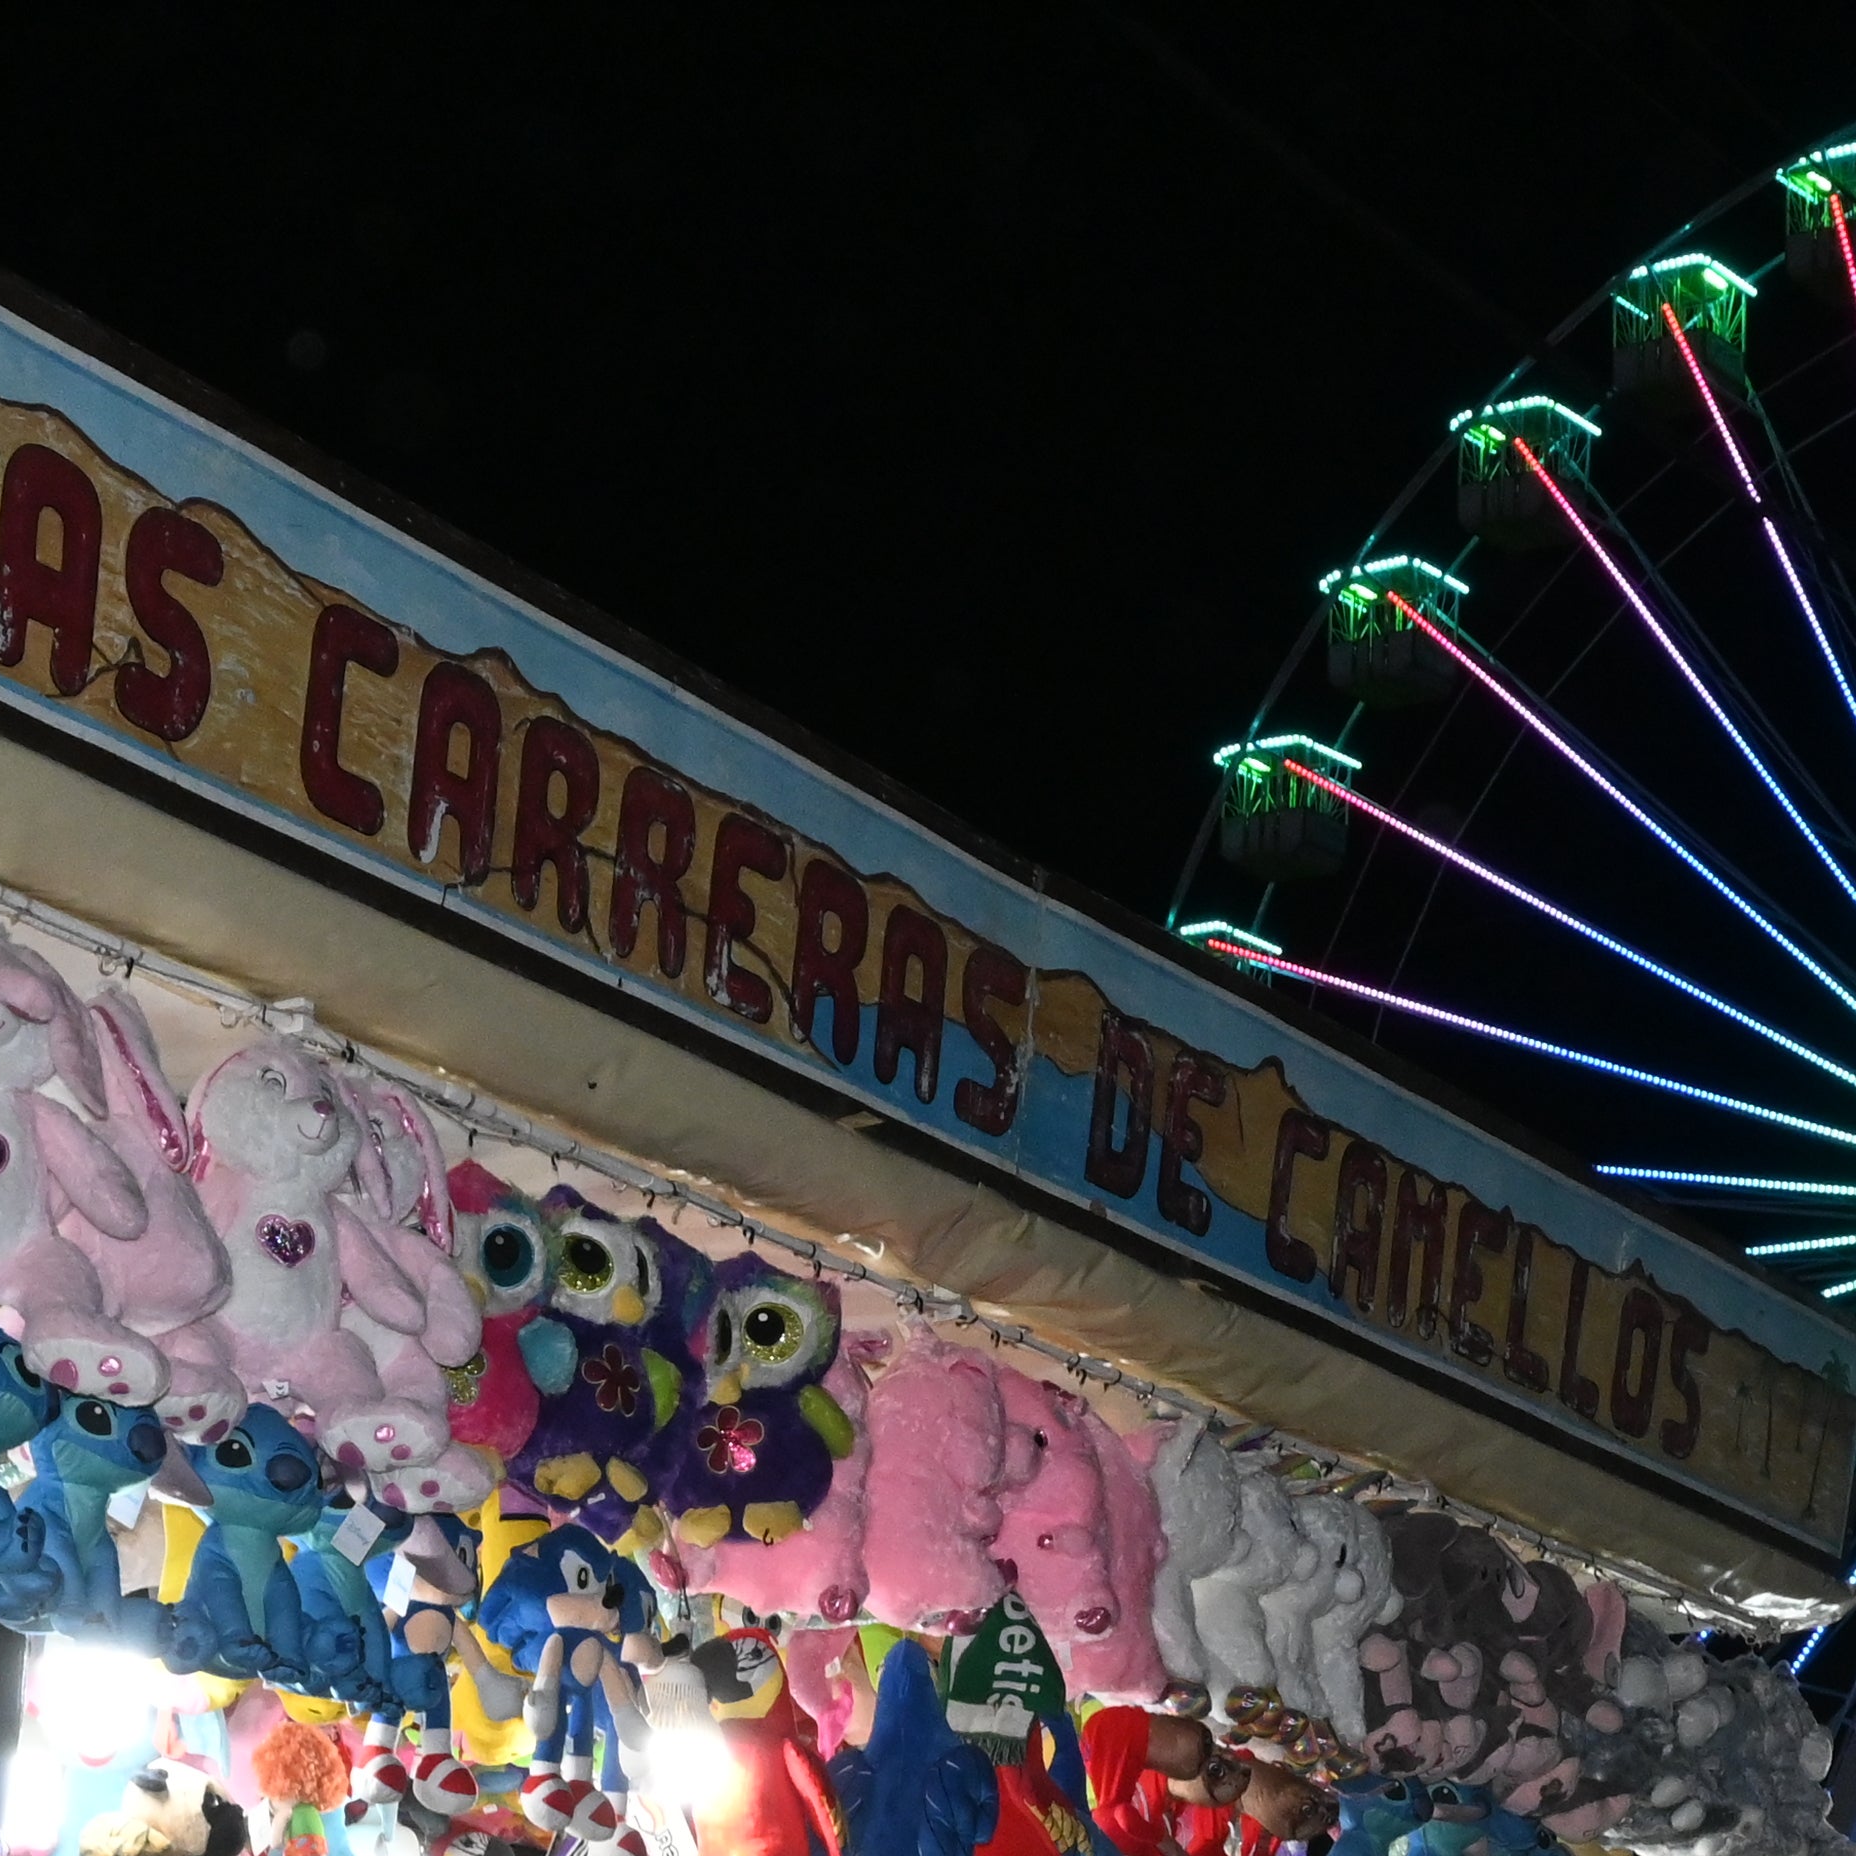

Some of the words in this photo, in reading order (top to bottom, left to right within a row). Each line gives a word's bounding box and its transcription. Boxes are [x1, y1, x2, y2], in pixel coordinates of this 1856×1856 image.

[300, 602, 1032, 1138] CARRERAS
[1085, 1005, 1226, 1238] DE
[1265, 1109, 1711, 1461] CAMELLOS
